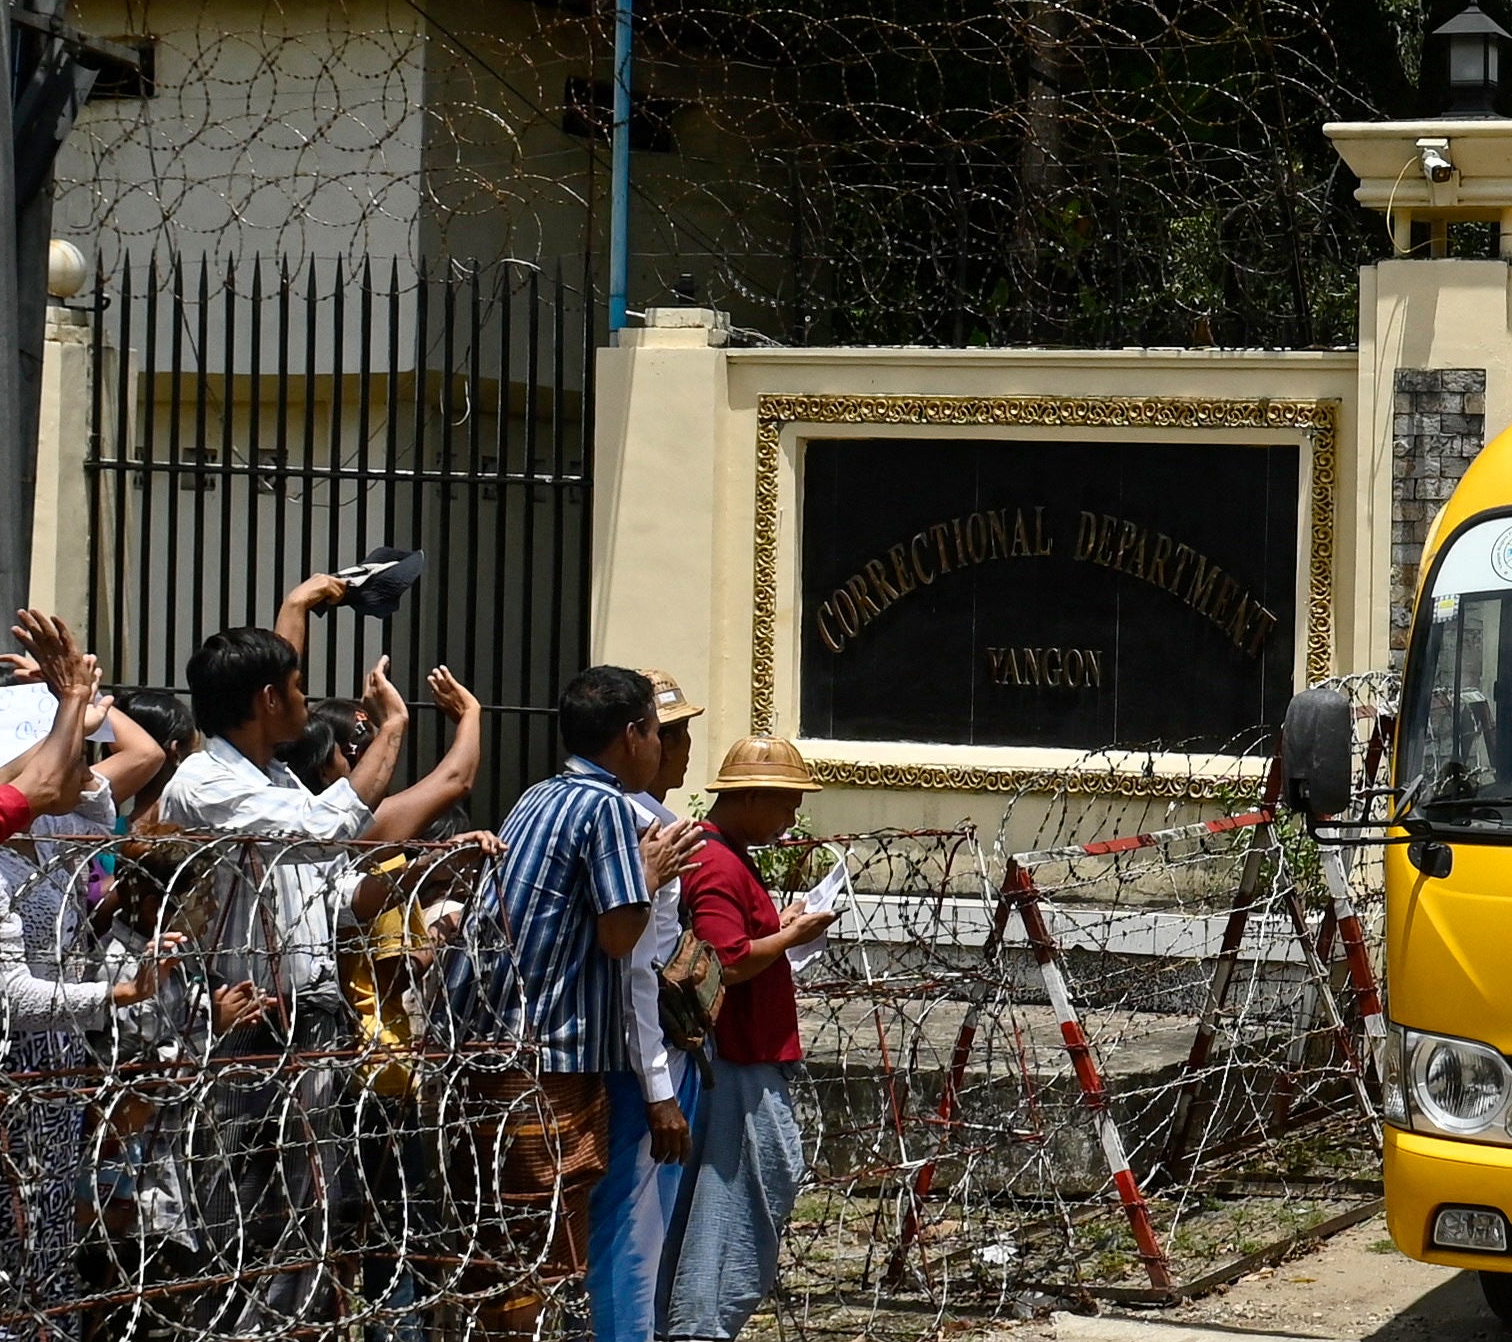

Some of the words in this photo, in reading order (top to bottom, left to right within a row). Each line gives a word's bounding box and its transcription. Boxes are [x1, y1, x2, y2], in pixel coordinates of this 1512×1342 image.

[816, 504, 1054, 655] CORRECTIONAL
[1074, 510, 1280, 660] DEPARTMENT
[985, 646, 1105, 688] YANGON
